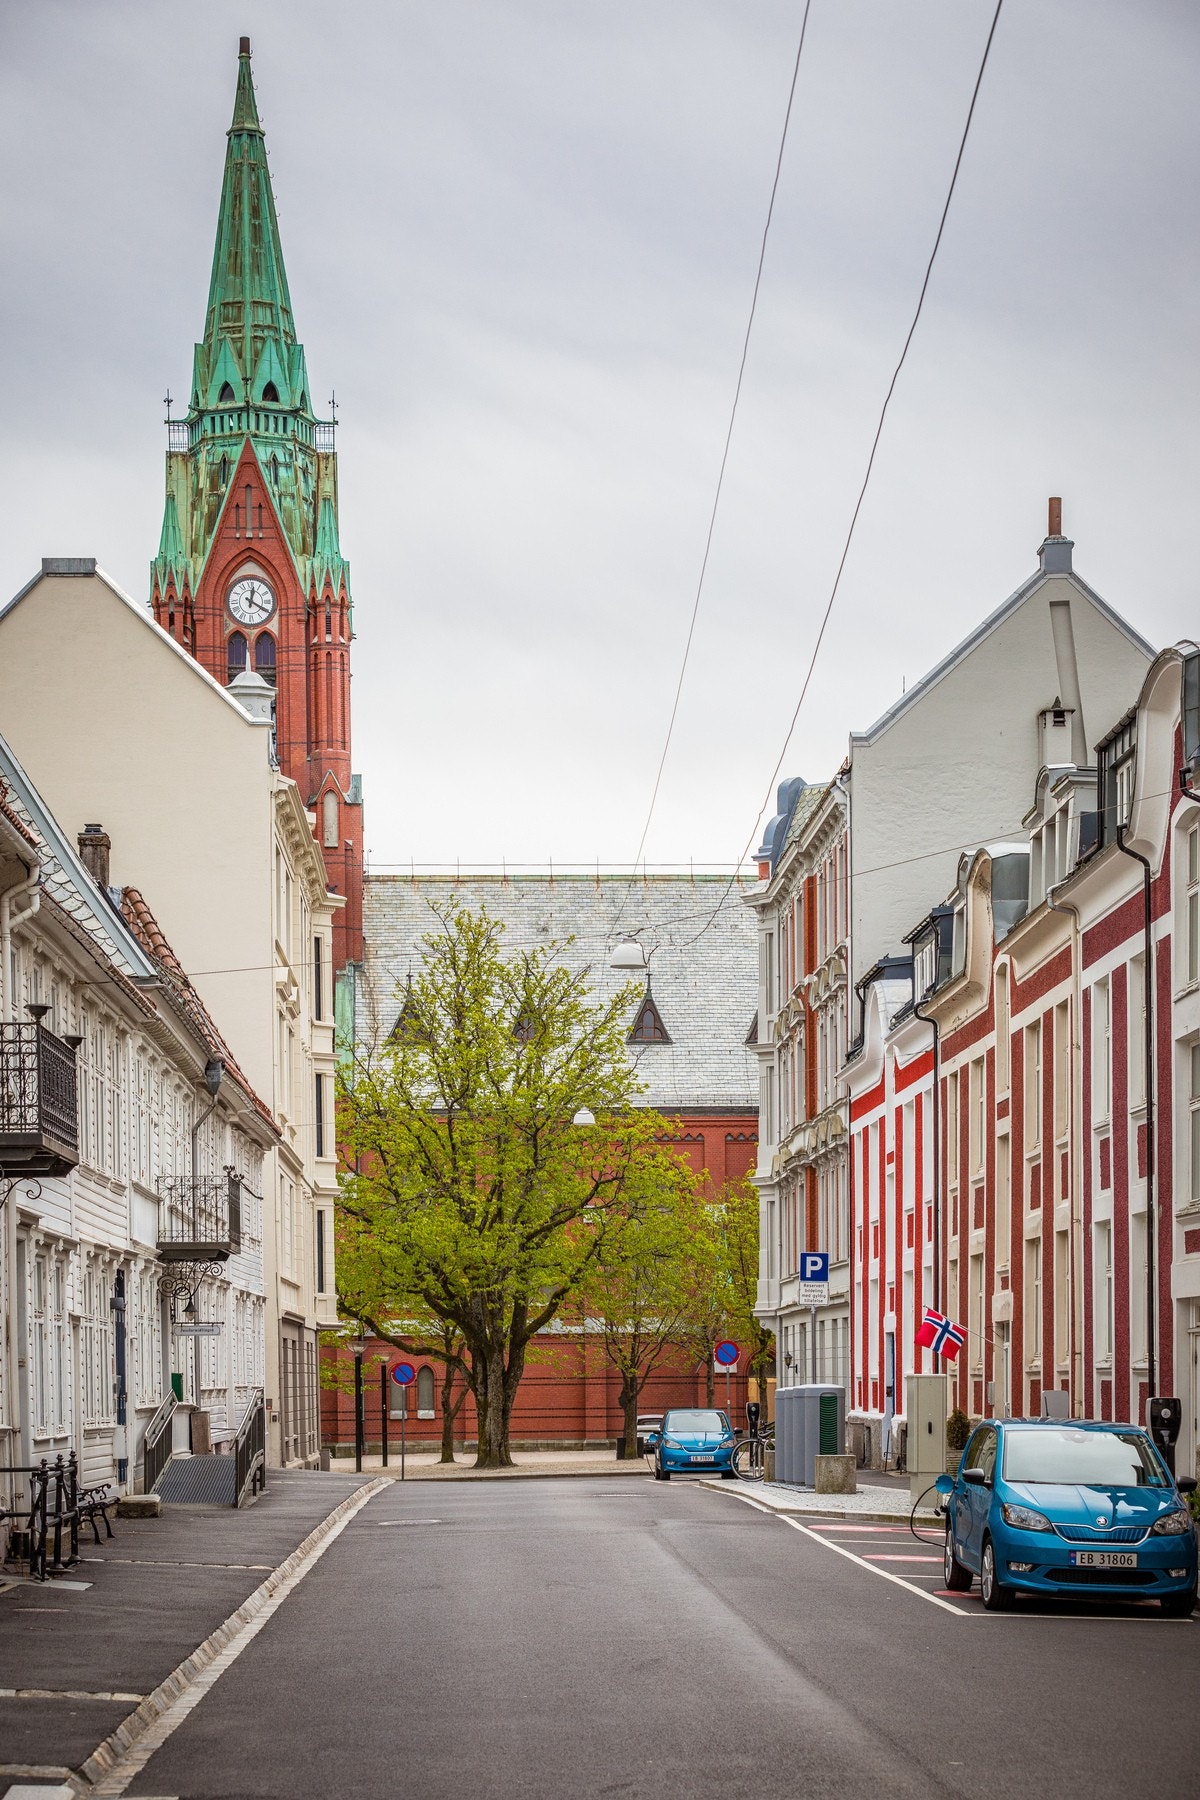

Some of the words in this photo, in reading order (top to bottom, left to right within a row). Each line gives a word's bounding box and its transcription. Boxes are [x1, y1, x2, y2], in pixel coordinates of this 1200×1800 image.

[806, 1256, 823, 1278] P
[1080, 1553, 1094, 1564] EB
[1099, 1554, 1133, 1565] 31806
